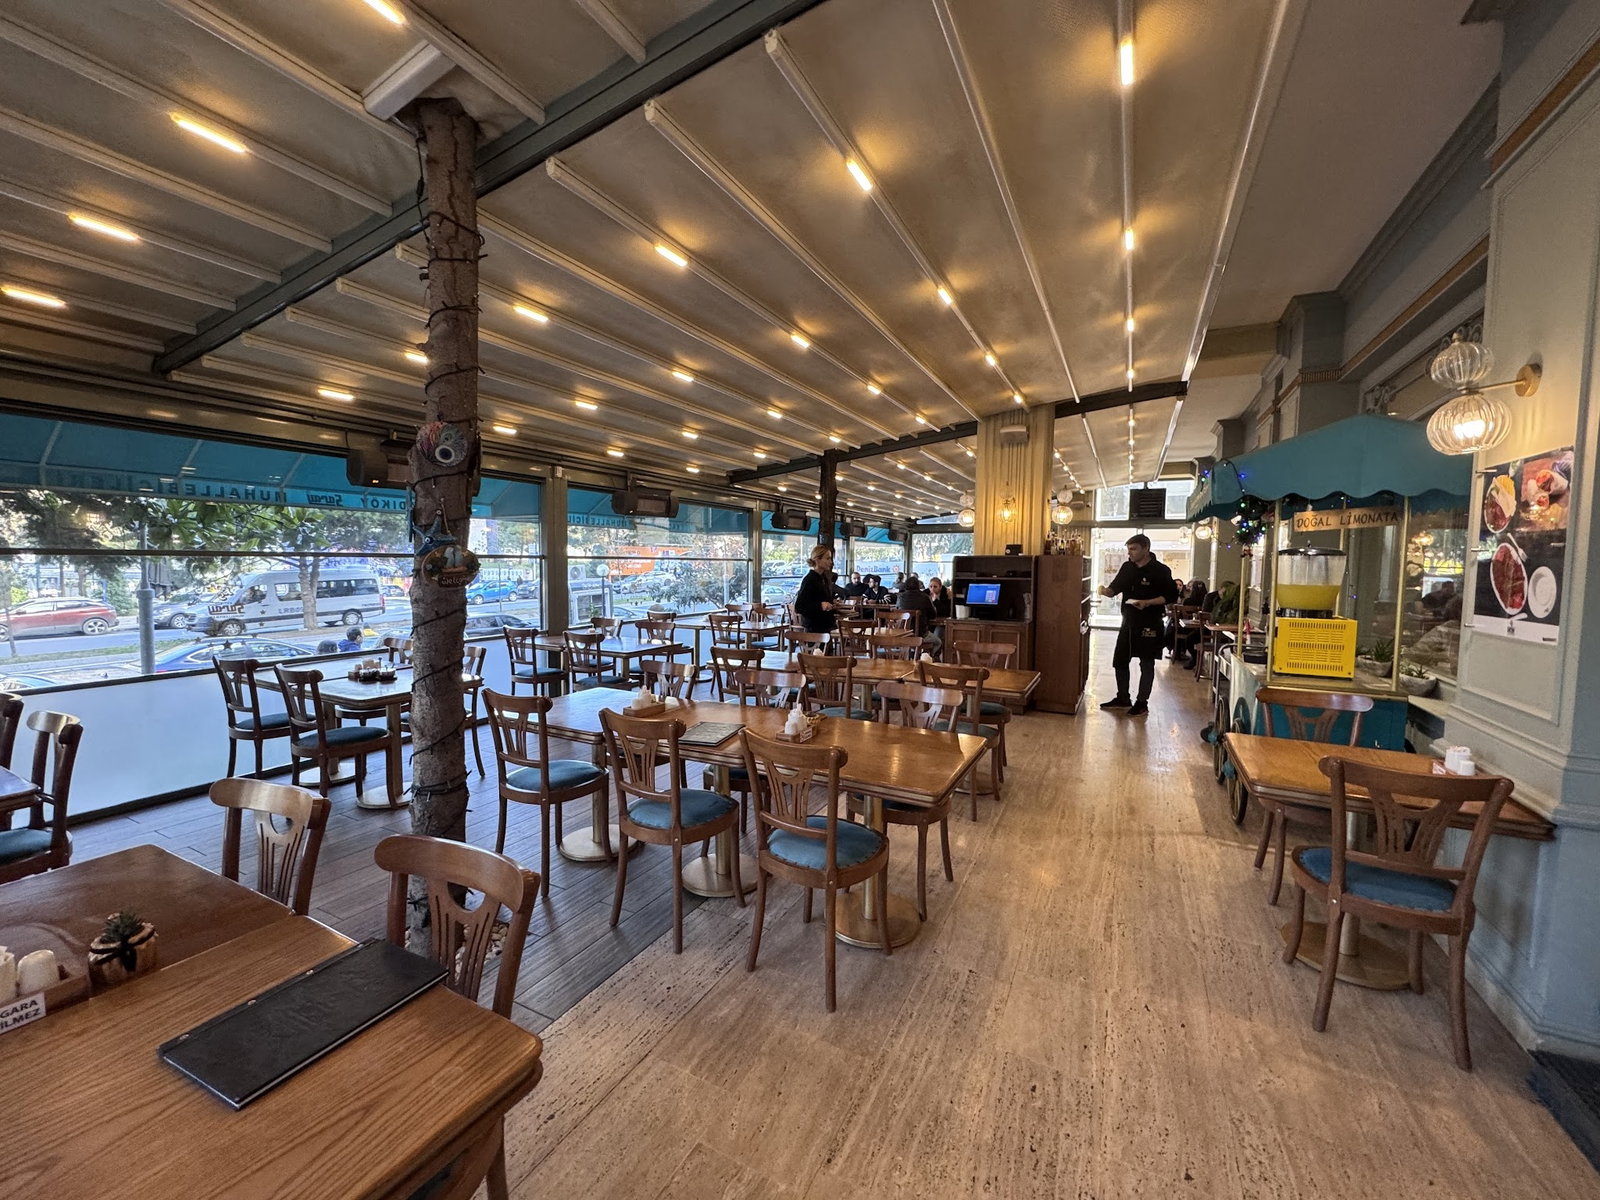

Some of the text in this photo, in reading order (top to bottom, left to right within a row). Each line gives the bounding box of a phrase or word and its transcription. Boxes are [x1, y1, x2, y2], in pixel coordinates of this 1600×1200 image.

[1297, 511, 1398, 528] DOĞAL LİMONATA
[857, 564, 891, 573] DenizBank
[0, 1000, 38, 1018] GARA
